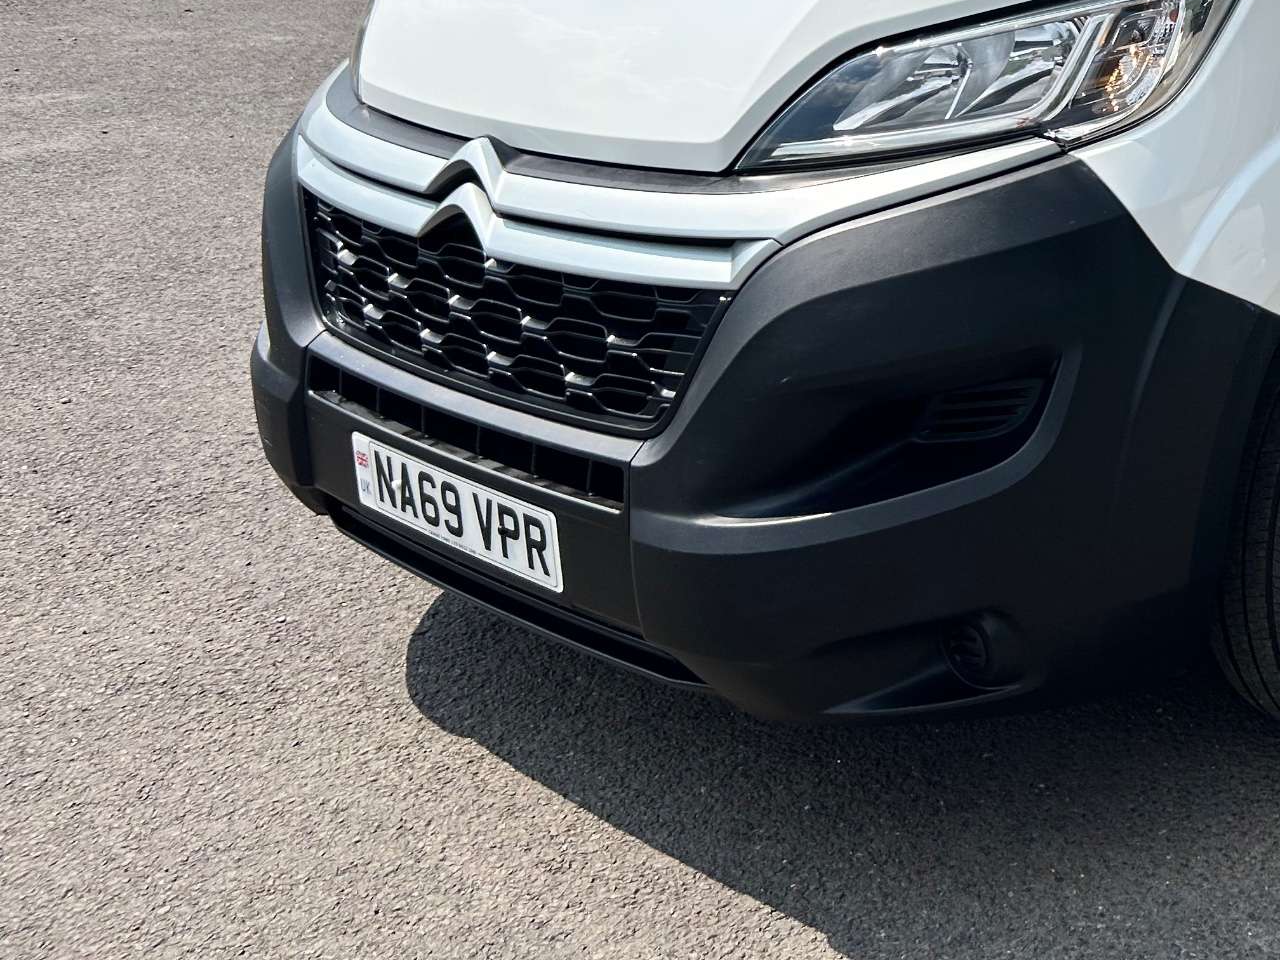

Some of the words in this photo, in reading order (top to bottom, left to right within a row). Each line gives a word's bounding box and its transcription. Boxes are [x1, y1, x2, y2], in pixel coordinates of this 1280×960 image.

[360, 478, 371, 494] UK
[374, 450, 464, 538] NA69
[472, 492, 551, 577] VPR
